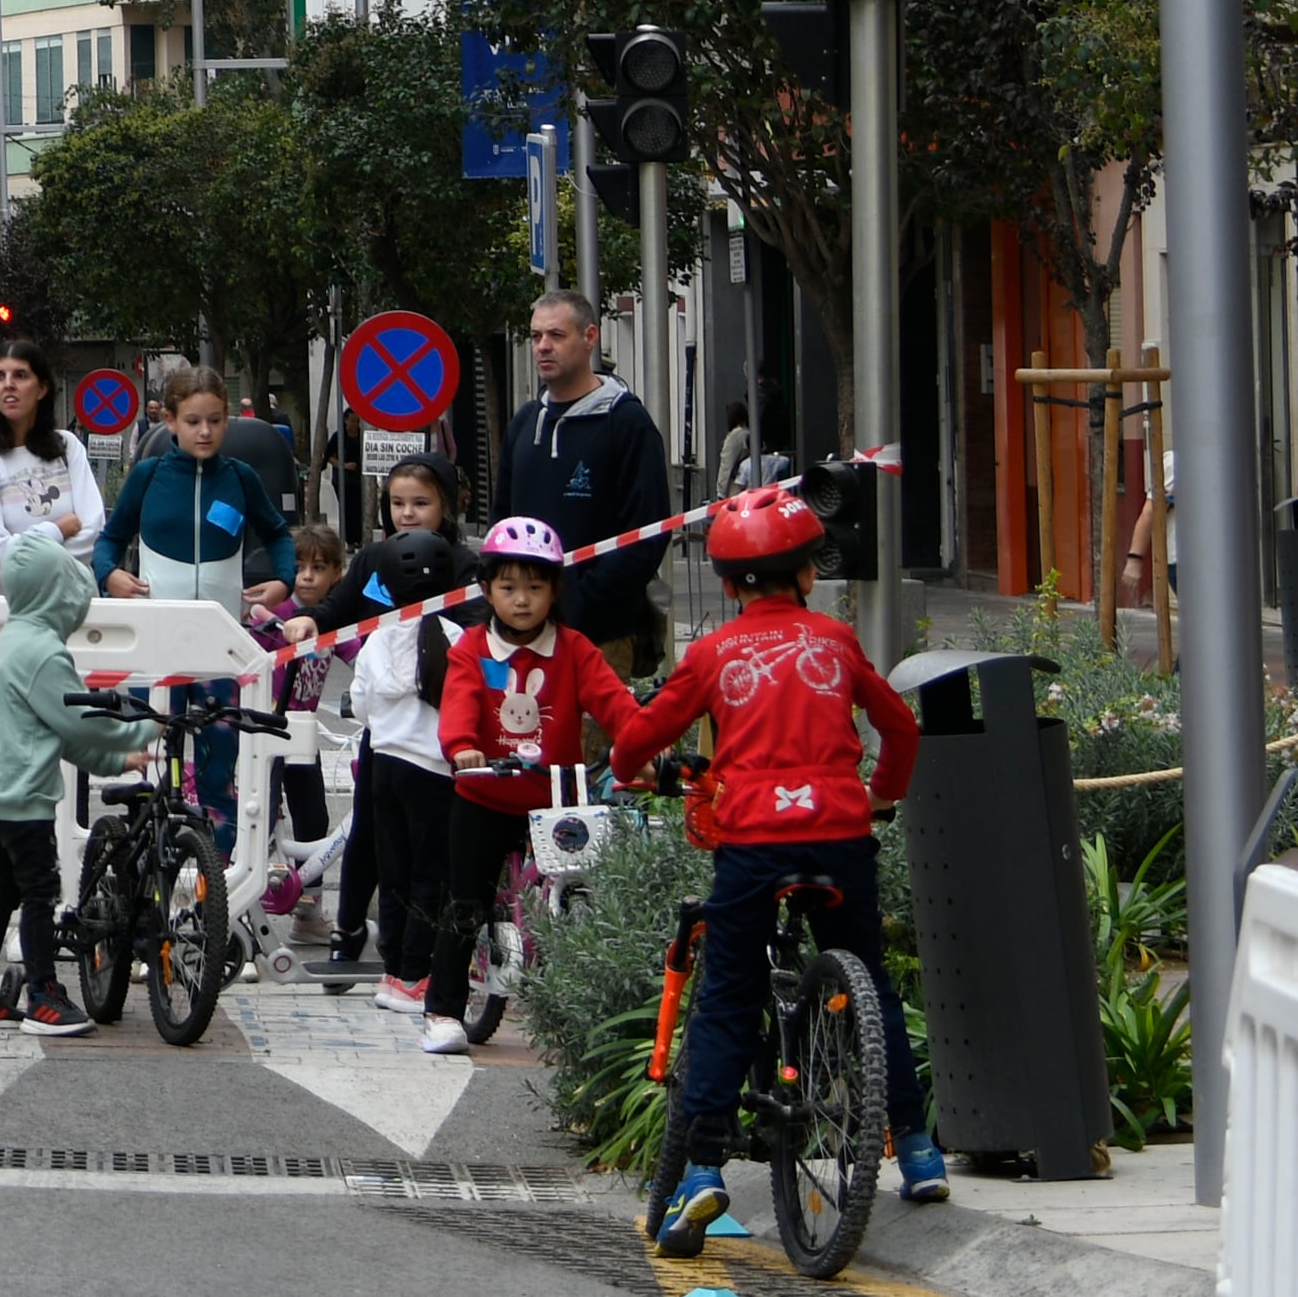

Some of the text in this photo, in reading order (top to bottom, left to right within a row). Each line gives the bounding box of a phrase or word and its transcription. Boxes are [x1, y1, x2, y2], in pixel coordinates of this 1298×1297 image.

[530, 155, 541, 255] P
[381, 443, 393, 453] SIN
[396, 443, 423, 454] COCHE
